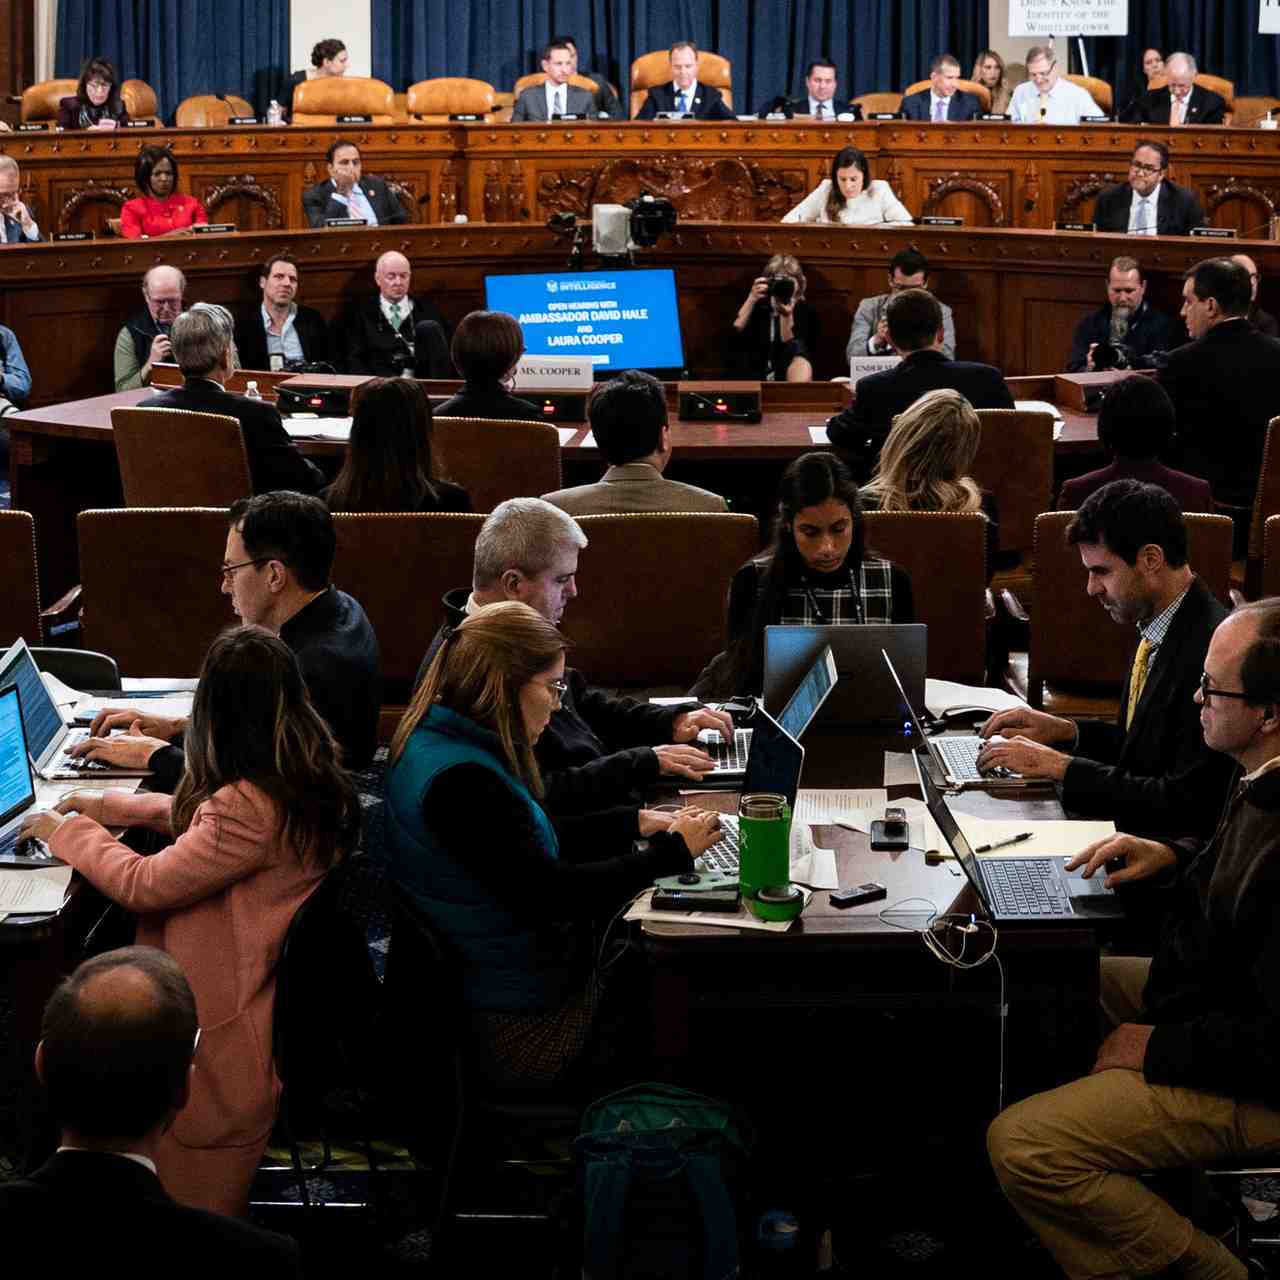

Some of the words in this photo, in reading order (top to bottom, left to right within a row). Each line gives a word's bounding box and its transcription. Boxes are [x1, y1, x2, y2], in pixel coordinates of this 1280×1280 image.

[519, 311, 590, 325] AMBASSADOR
[591, 310, 621, 321] DAVID
[622, 308, 649, 320] HALE
[576, 325, 593, 334] AND
[547, 335, 580, 347] LAURA
[581, 333, 624, 345] COOPER
[539, 367, 582, 377] COOPER
